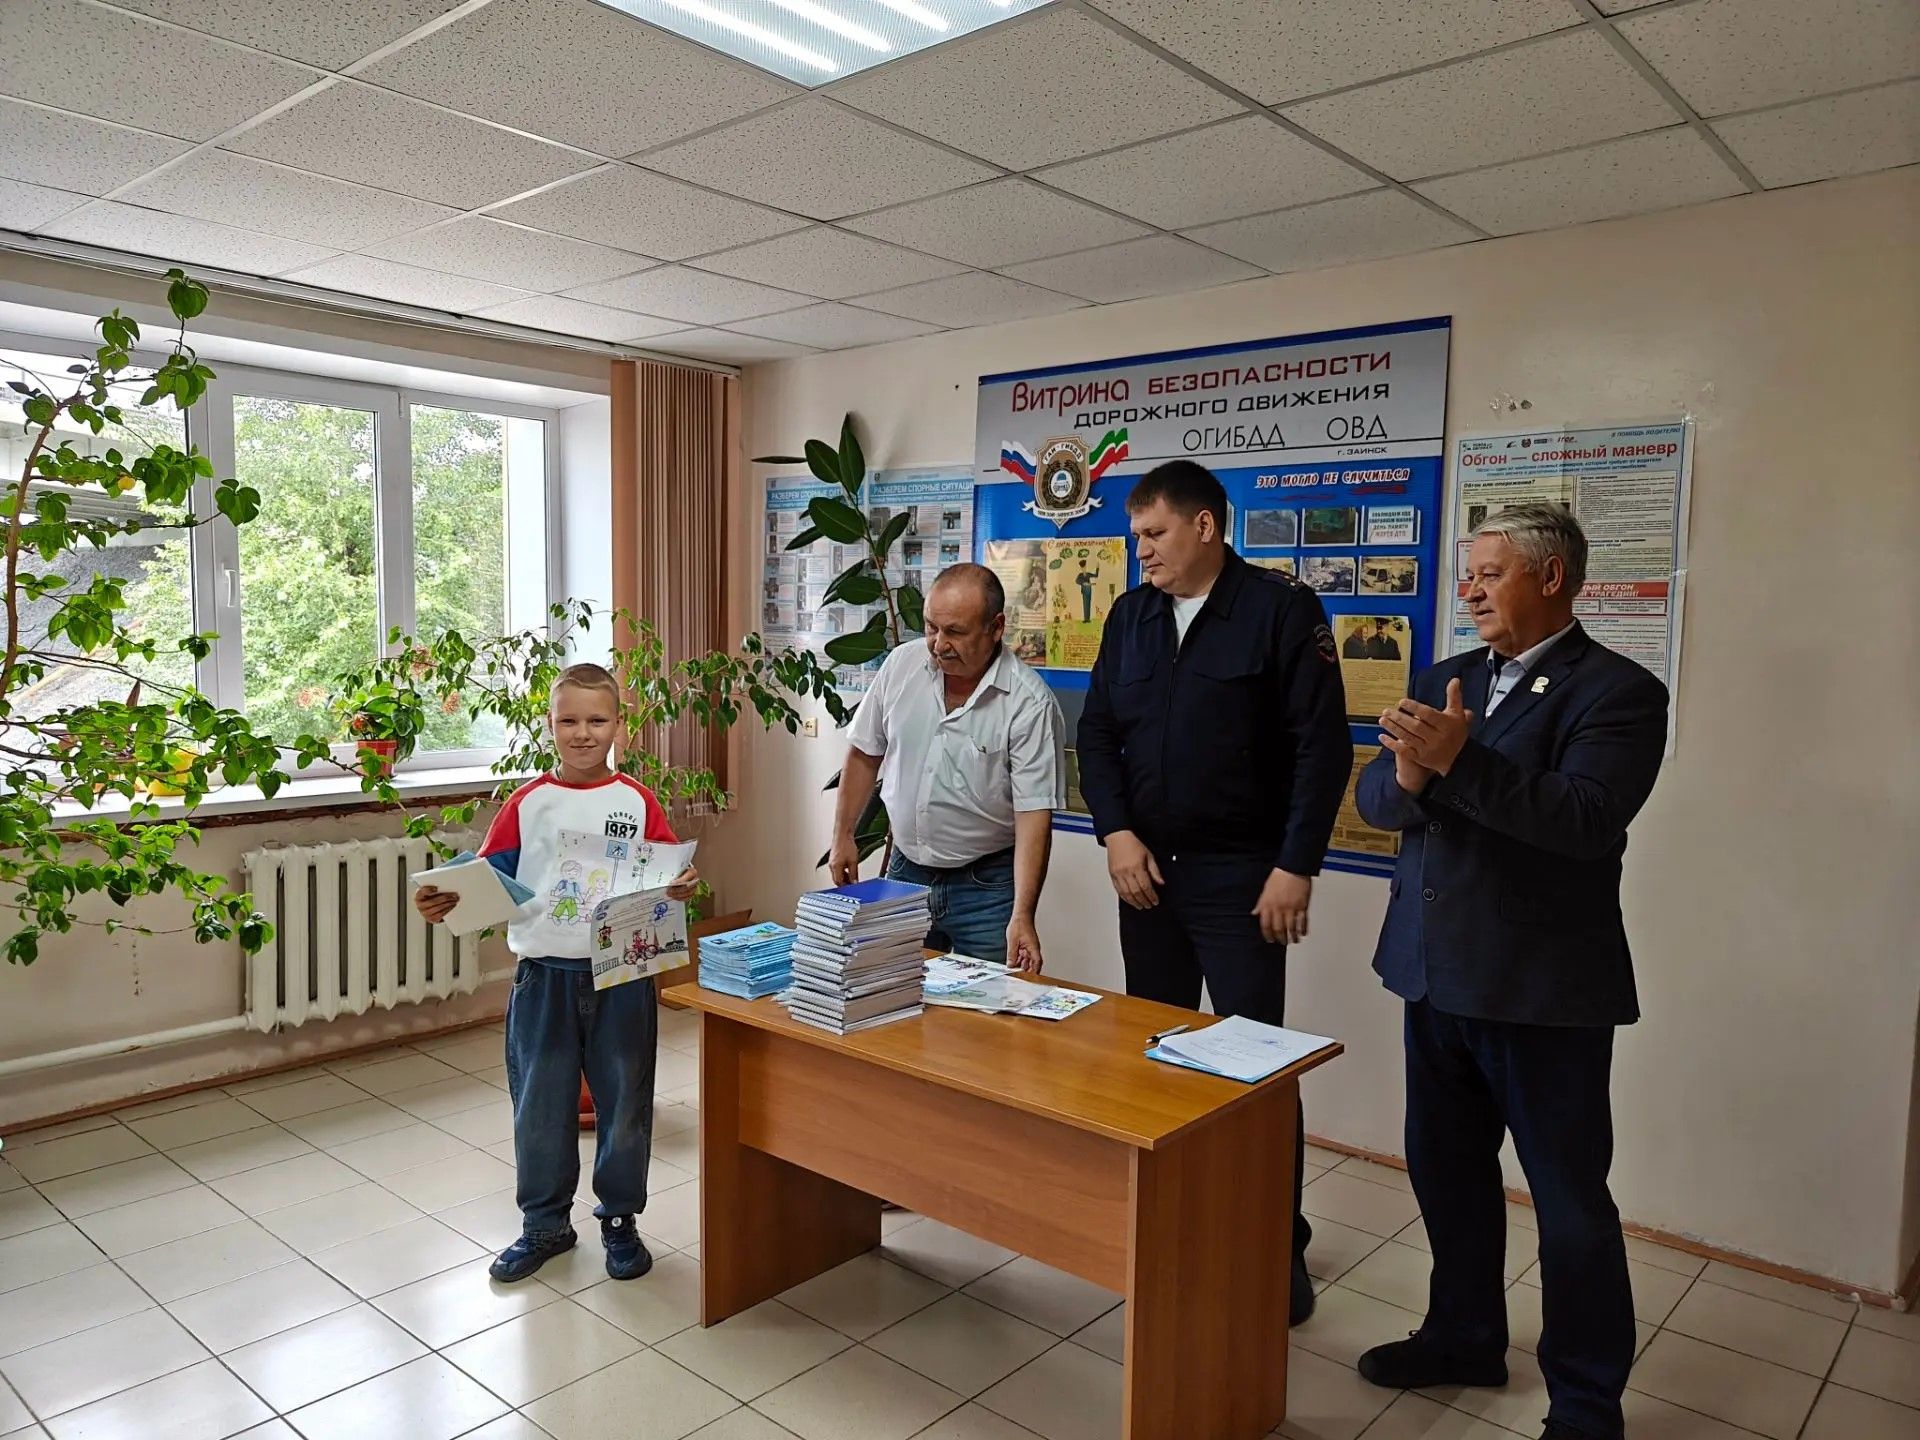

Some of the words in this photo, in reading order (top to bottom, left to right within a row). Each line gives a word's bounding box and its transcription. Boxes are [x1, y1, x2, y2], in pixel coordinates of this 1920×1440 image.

[1012, 379, 1131, 417] Витрина
[1148, 351, 1391, 396] БЕЗОПАСНОСТИ
[1074, 398, 1228, 430] ДОРОЖНОГО
[1237, 383, 1390, 412] ДВИЖЕНИЯ
[1182, 422, 1285, 452] ОГИБДД
[1326, 414, 1388, 441] ОВД
[1645, 427, 1681, 436] ВОДИТЕЛЮ
[1347, 446, 1388, 456] ЗАИНСК
[1462, 453, 1507, 467] Обгон
[1532, 445, 1606, 462] сложный
[1612, 442, 1677, 458] маневр
[1256, 475, 1277, 488] ЭТО
[1281, 474, 1319, 488] МОГЛО
[1323, 472, 1339, 485] НЕ
[1342, 468, 1410, 484] СЛУЧИТЬСЯ
[909, 484, 940, 493] СПОРНЫЕ
[1603, 583, 1634, 591] ОБГОН
[605, 822, 638, 840] 1987
